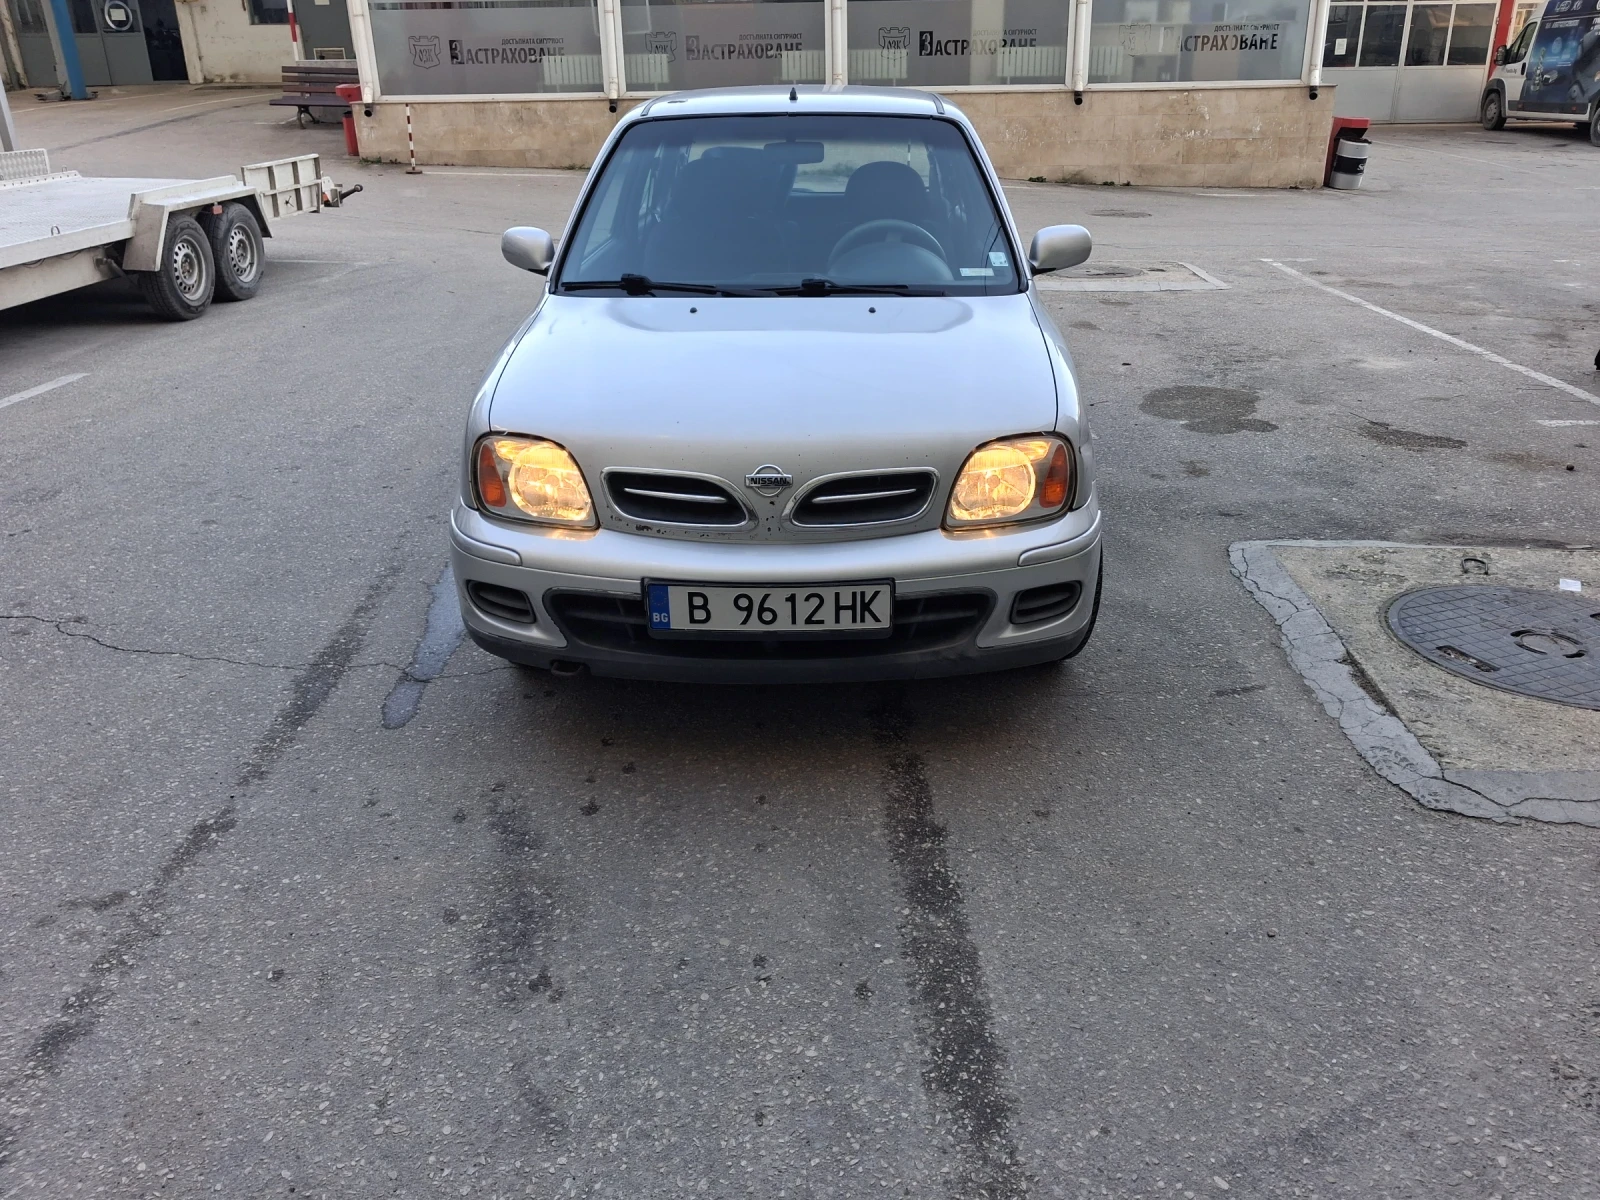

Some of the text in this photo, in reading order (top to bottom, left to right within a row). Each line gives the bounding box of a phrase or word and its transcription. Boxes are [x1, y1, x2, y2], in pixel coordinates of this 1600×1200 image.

[1164, 27, 1279, 52] СТРАХОВАНЕ
[750, 477, 787, 485] NISSAN
[687, 591, 711, 624] B
[652, 612, 669, 623] BG
